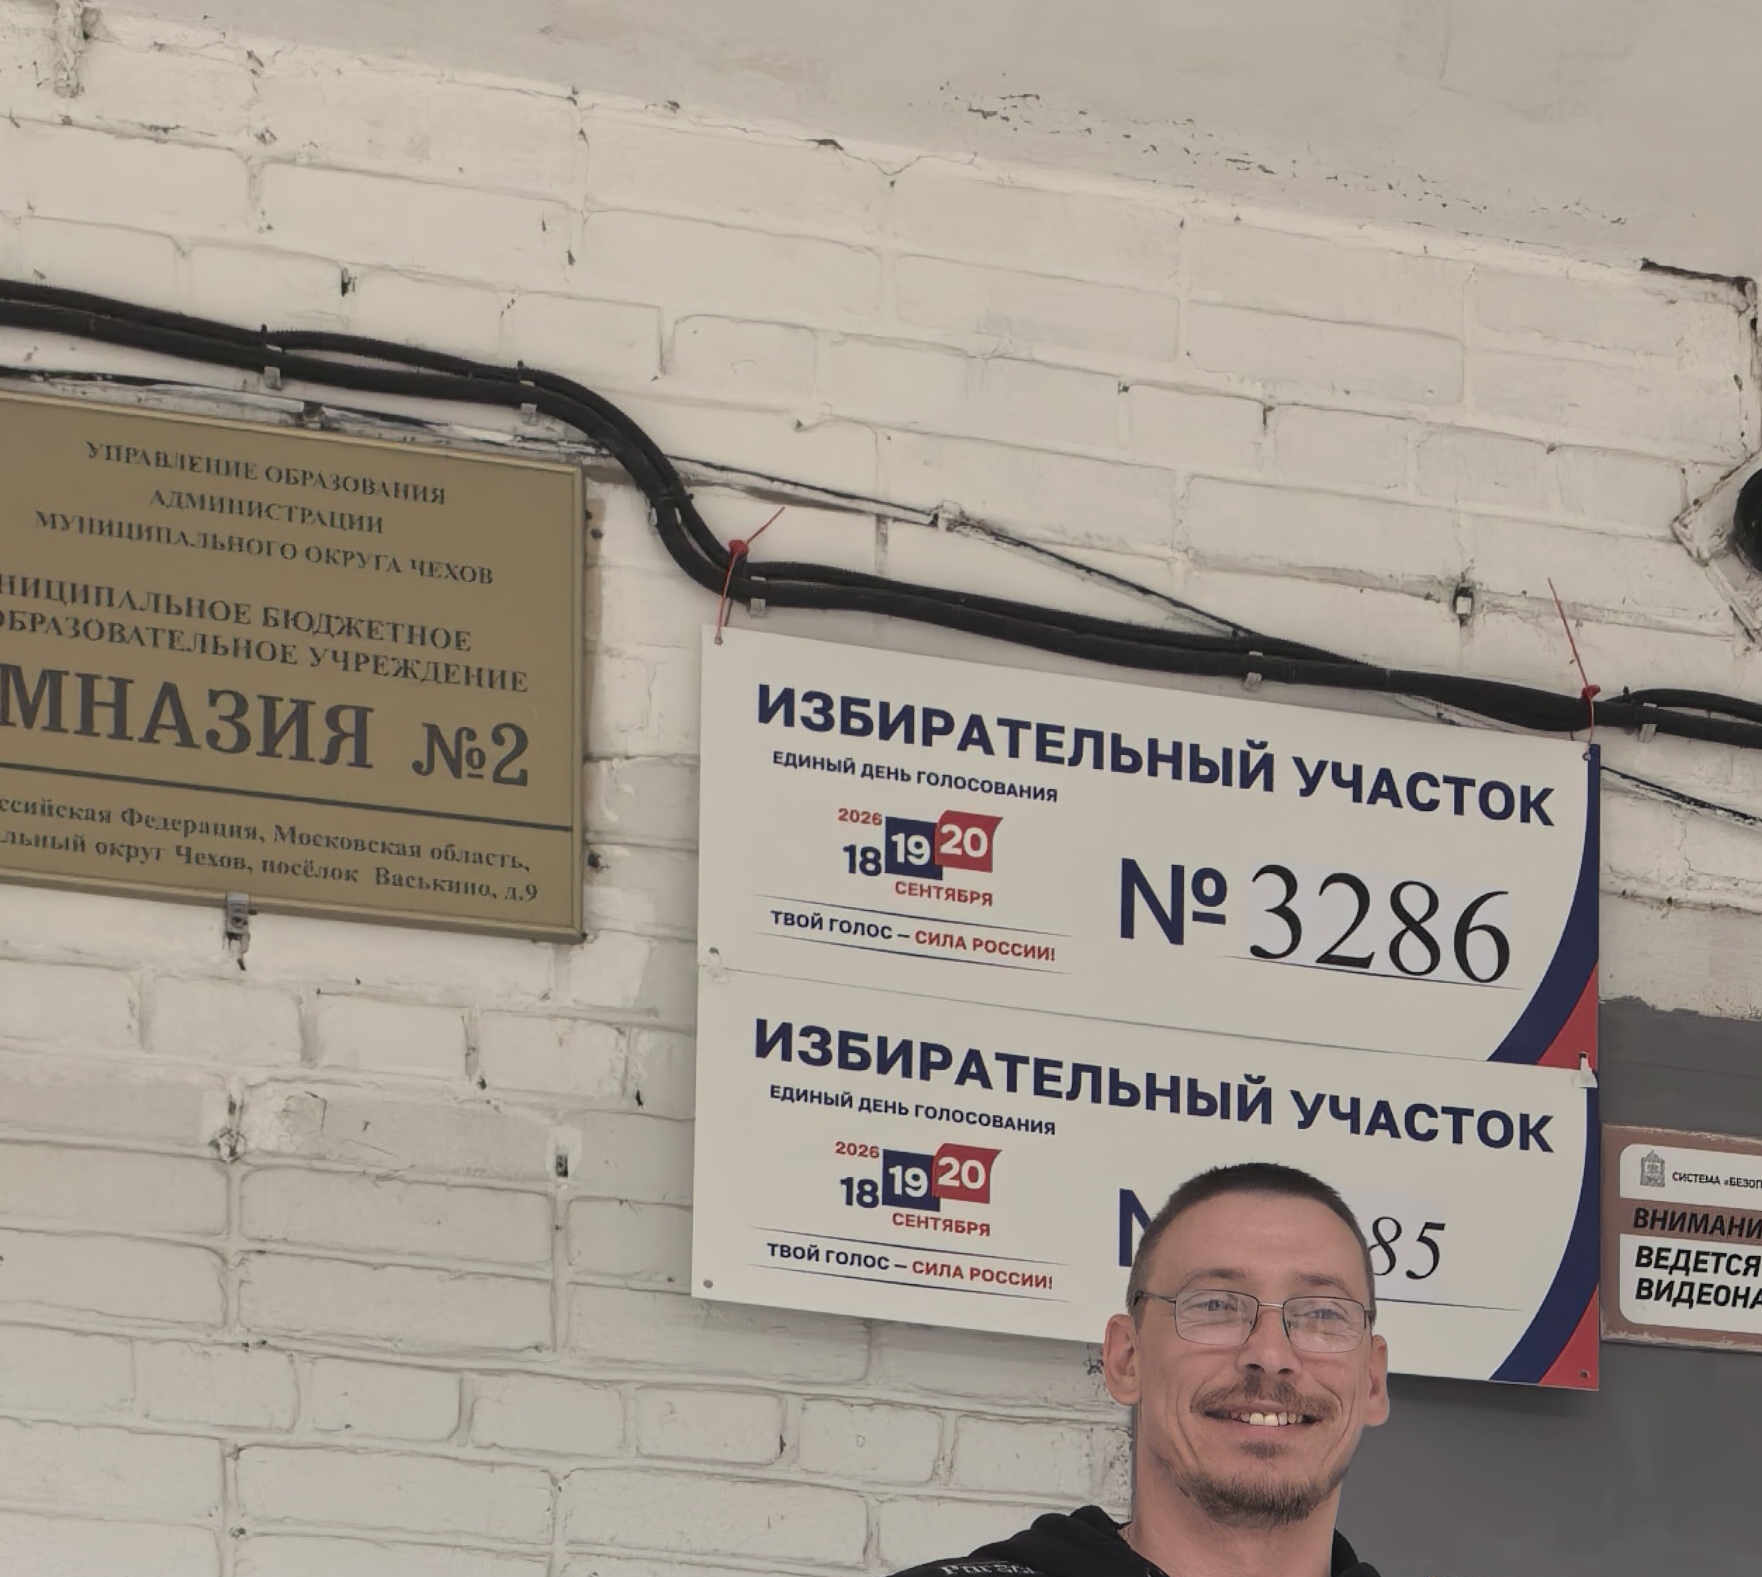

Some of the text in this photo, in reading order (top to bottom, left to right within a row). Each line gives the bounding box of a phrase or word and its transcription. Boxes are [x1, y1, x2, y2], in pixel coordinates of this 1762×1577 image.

[85, 440, 446, 505] УПРАВЛЕНИЕ ОБРАЗОВАНИЯ
[150, 489, 384, 535] АДМИНИСТРАЦИИ
[35, 510, 494, 586] МУНИЦИПАЛЬНОГО ОКРУГА ЧЕХОВ
[262, 605, 472, 652] БЮДЖЕТНОЕ
[308, 645, 529, 693] УЧРЕЖДЕНИЕ
[0, 663, 529, 787] МНАЗИЯ №2
[757, 683, 1555, 827] ИЗБИРАТЕЛЬНЫЙ УЧАСТОК
[772, 750, 1058, 803] ЕДИНЫЙ ДЕНЬ ГОЛОСОВАНИЯ
[120, 807, 265, 844] Федерация,
[273, 824, 422, 859] Московская
[429, 844, 531, 873] область,
[837, 807, 883, 826] 2026
[95, 840, 163, 864] округ
[175, 844, 254, 872] Чехов,
[262, 858, 359, 882] посёлок
[375, 866, 498, 899] Васькино,
[842, 823, 988, 877] 18 19 20
[894, 880, 993, 907] СЕНТЯБРЯ
[770, 909, 823, 931] ТВОЙ
[828, 917, 893, 940] ГОЛОС
[914, 929, 967, 951] СИЛА
[971, 938, 1056, 962] РОССИИ!
[1119, 857, 1511, 984] № 3286
[754, 1017, 1555, 1154] ИЗБИРАТЕЛЬНЫЙ УЧАСТОК
[770, 1084, 1056, 1136] ЕДИНЫЙ ДЕНЬ ГОЛОСОВАНИЯ
[834, 1140, 880, 1159] 2026
[839, 1155, 986, 1209] 18 19 20
[1672, 1171, 1721, 1185] СИСТЕМА
[891, 1212, 991, 1237] СЕНТЯБРЯ
[1367, 1215, 1447, 1280] 85
[767, 1242, 820, 1263] ТВОЙ
[825, 1249, 890, 1271] ГОЛОС
[911, 1260, 964, 1281] СИЛА
[969, 1267, 1053, 1290] РОССИИ!
[1634, 1244, 1762, 1278] ВЕДЕТСЯ
